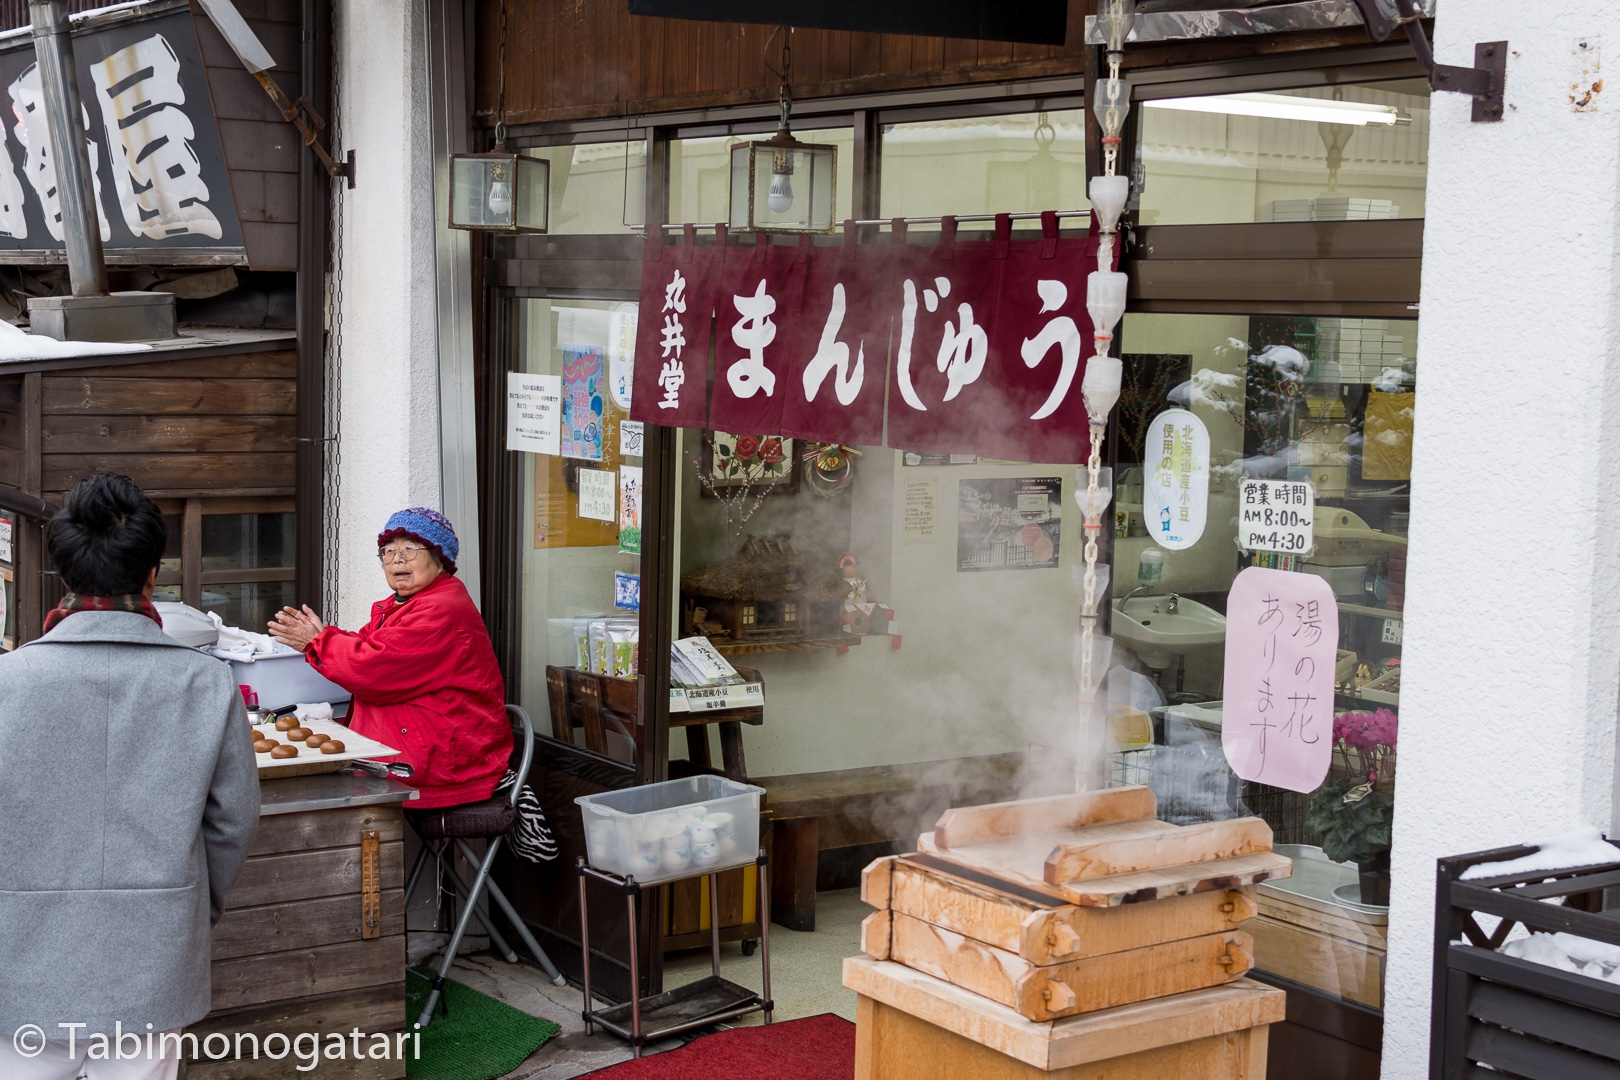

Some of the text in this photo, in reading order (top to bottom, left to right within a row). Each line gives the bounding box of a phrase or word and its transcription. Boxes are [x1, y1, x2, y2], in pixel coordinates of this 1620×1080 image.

[657, 268, 687, 411] 丸井堂
[725, 275, 1082, 421] まんじゅう
[1161, 423, 1174, 488] 使用の店
[1179, 424, 1193, 522] 北海道産小豆
[688, 687, 729, 699] 北海道産小豆
[745, 684, 760, 694] 使用
[1249, 592, 1285, 780] あります
[1279, 599, 1323, 745] 湯の花
